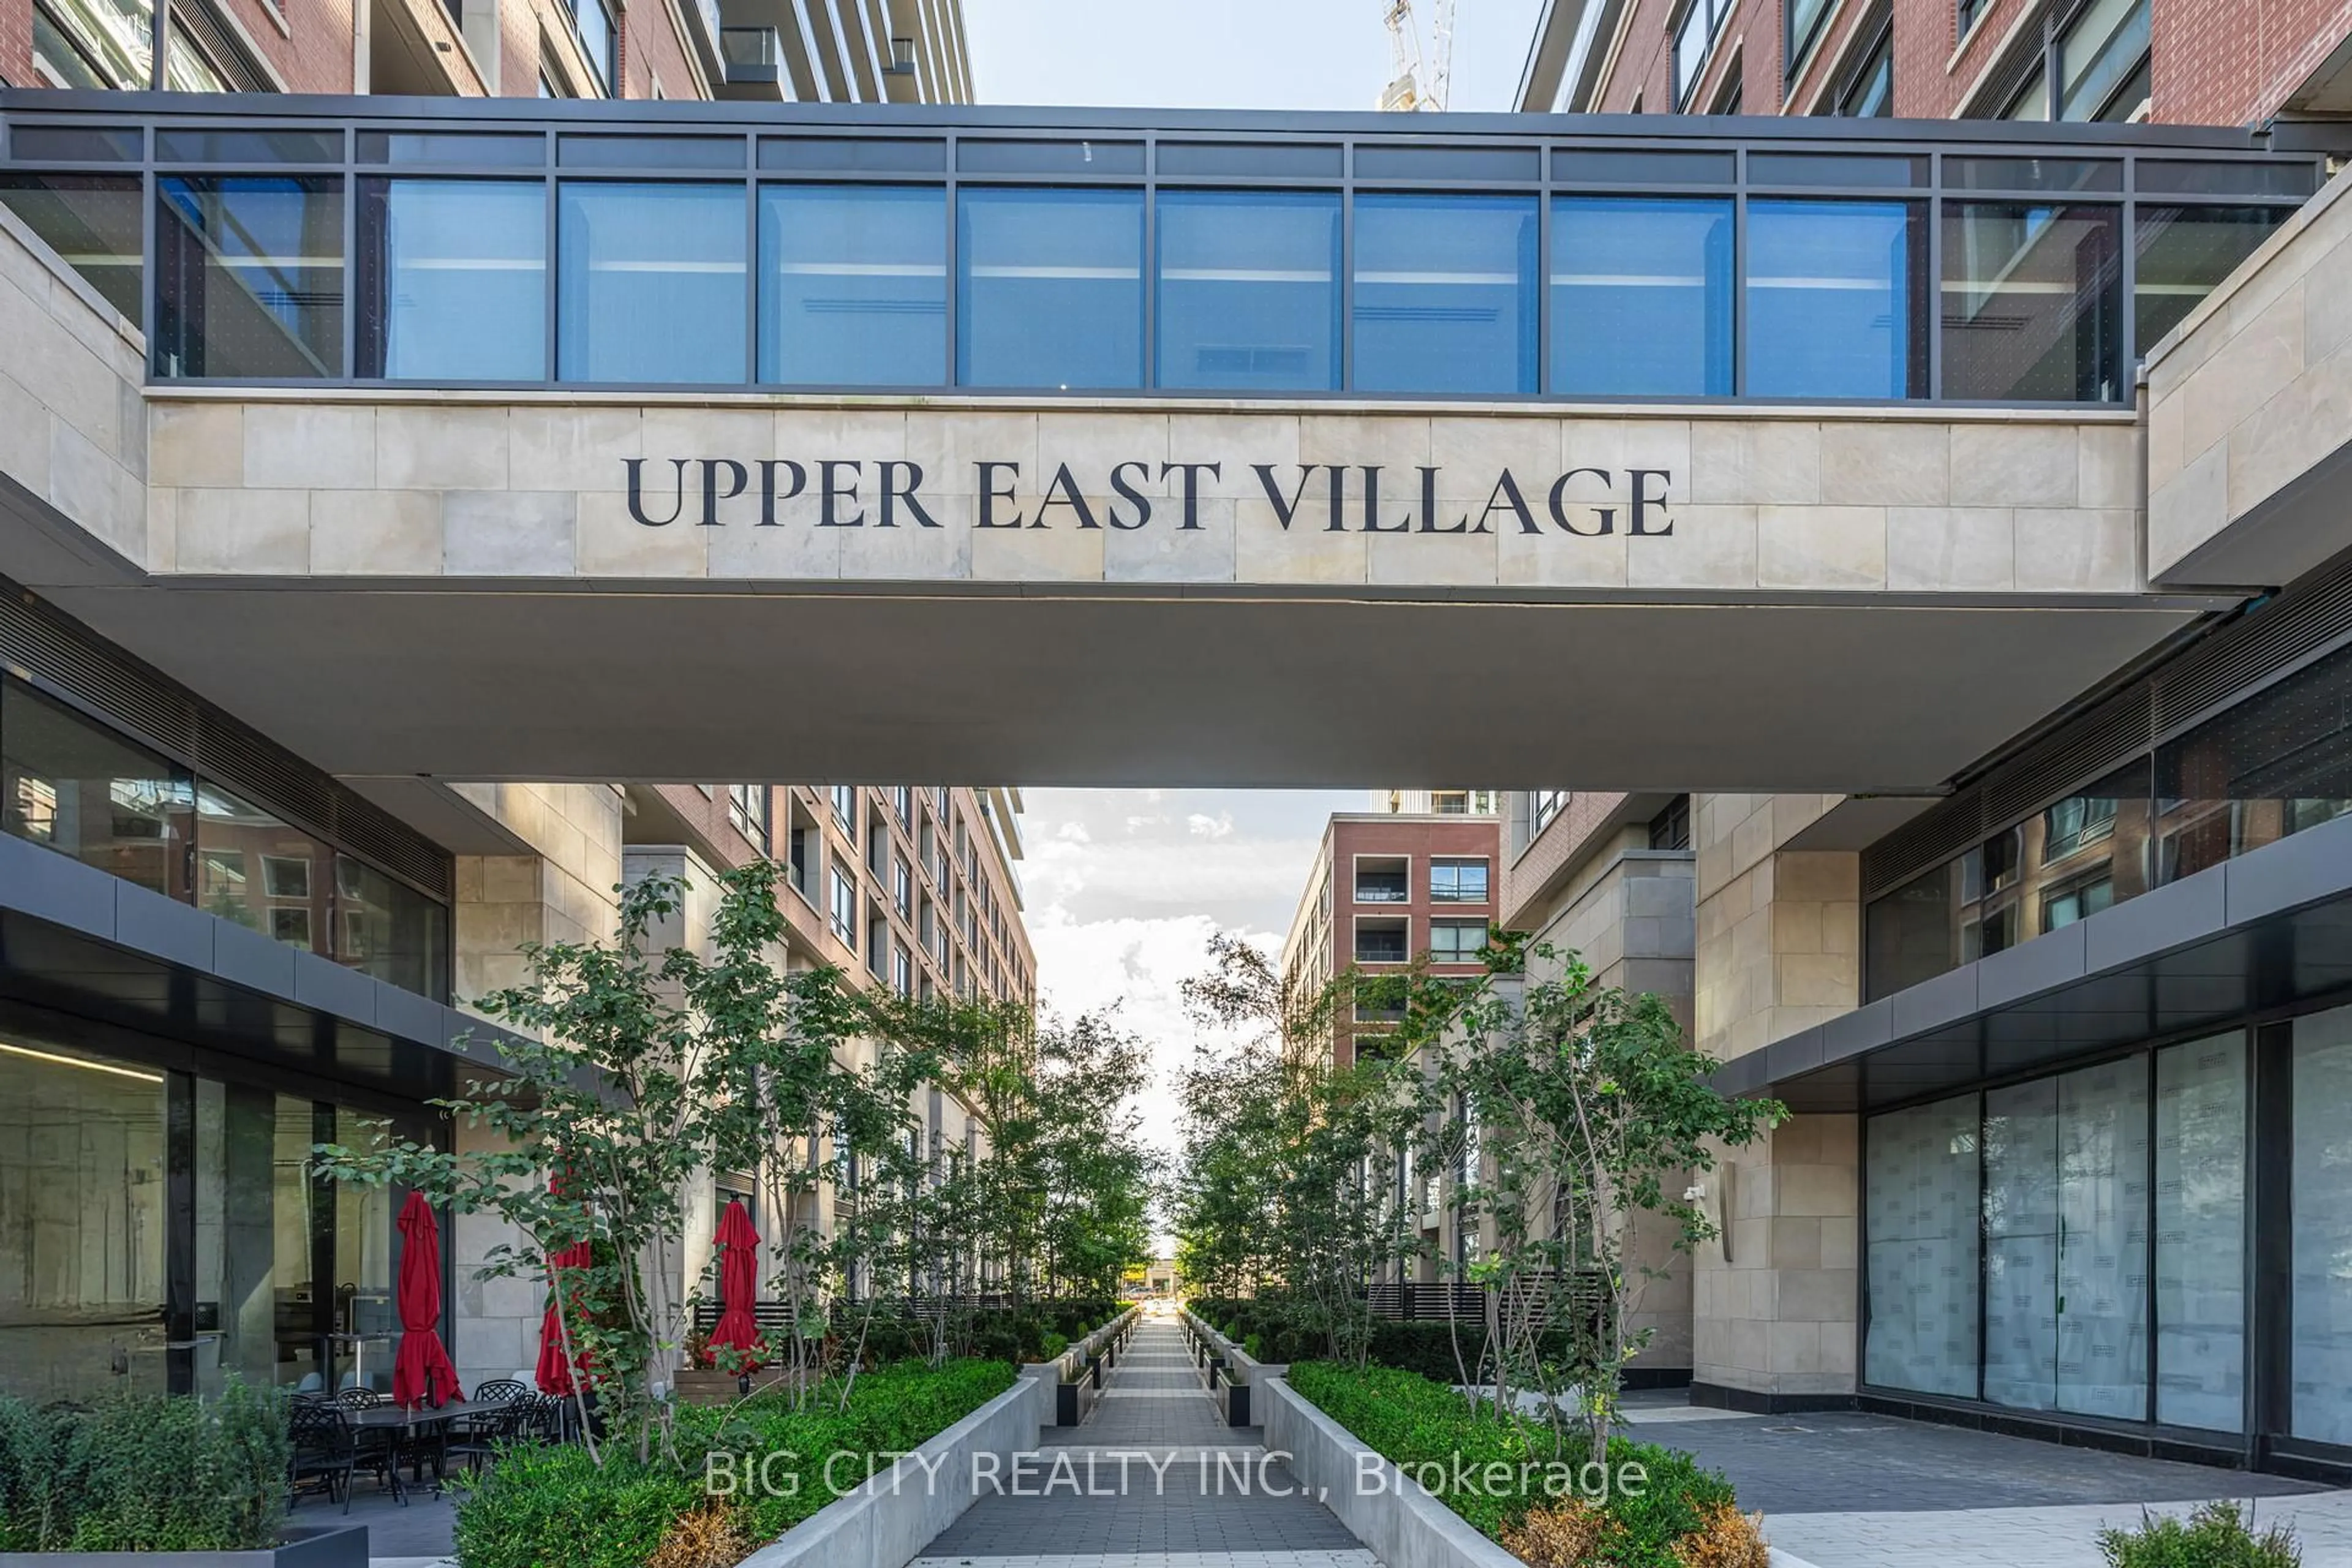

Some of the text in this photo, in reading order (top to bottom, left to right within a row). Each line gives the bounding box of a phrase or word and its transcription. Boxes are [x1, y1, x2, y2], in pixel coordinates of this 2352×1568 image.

[620, 458, 1674, 538] UPPER EAST VILLAGE
